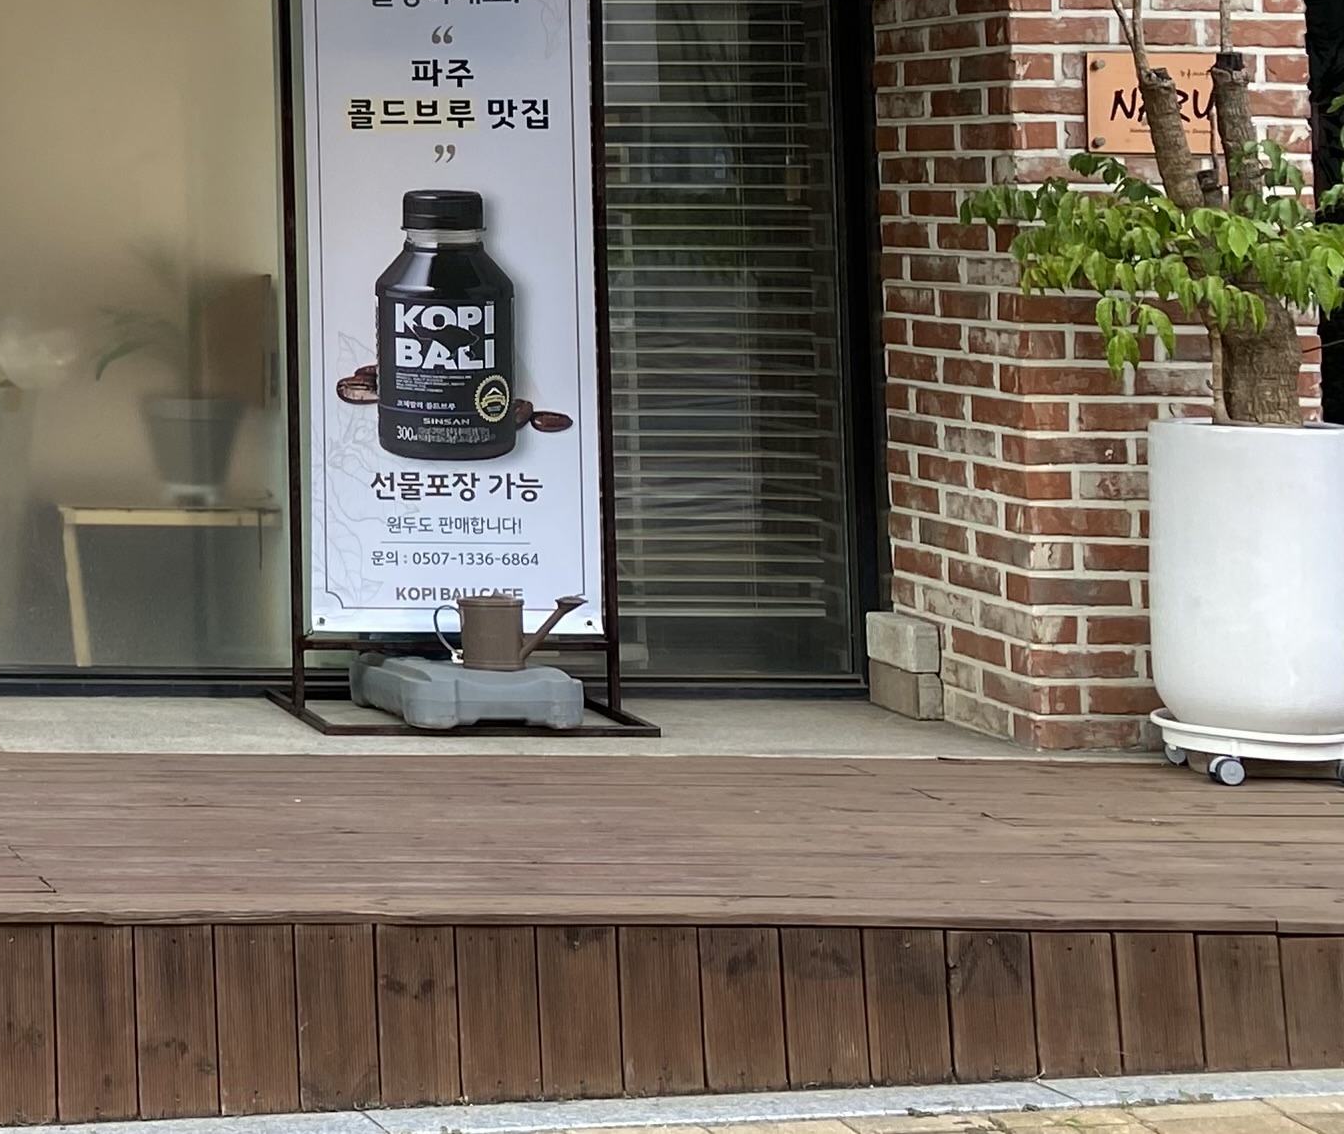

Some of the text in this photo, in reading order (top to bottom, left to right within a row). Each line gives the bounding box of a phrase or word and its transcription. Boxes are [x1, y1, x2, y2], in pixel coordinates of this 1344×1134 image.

[411, 59, 475, 88] 파주
[347, 98, 550, 130] 콜드브루 맛집
[1110, 87, 1213, 123] NRU
[394, 303, 495, 334] KOPI
[395, 337, 495, 370] BALI
[423, 417, 470, 426] SINSAN
[370, 472, 543, 502] 선물포장 가능
[386, 516, 522, 535] 원두도 판매합니다!
[371, 550, 399, 566] 문의
[412, 551, 539, 566] 0507-1336-6864
[395, 587, 436, 601] KOPI
